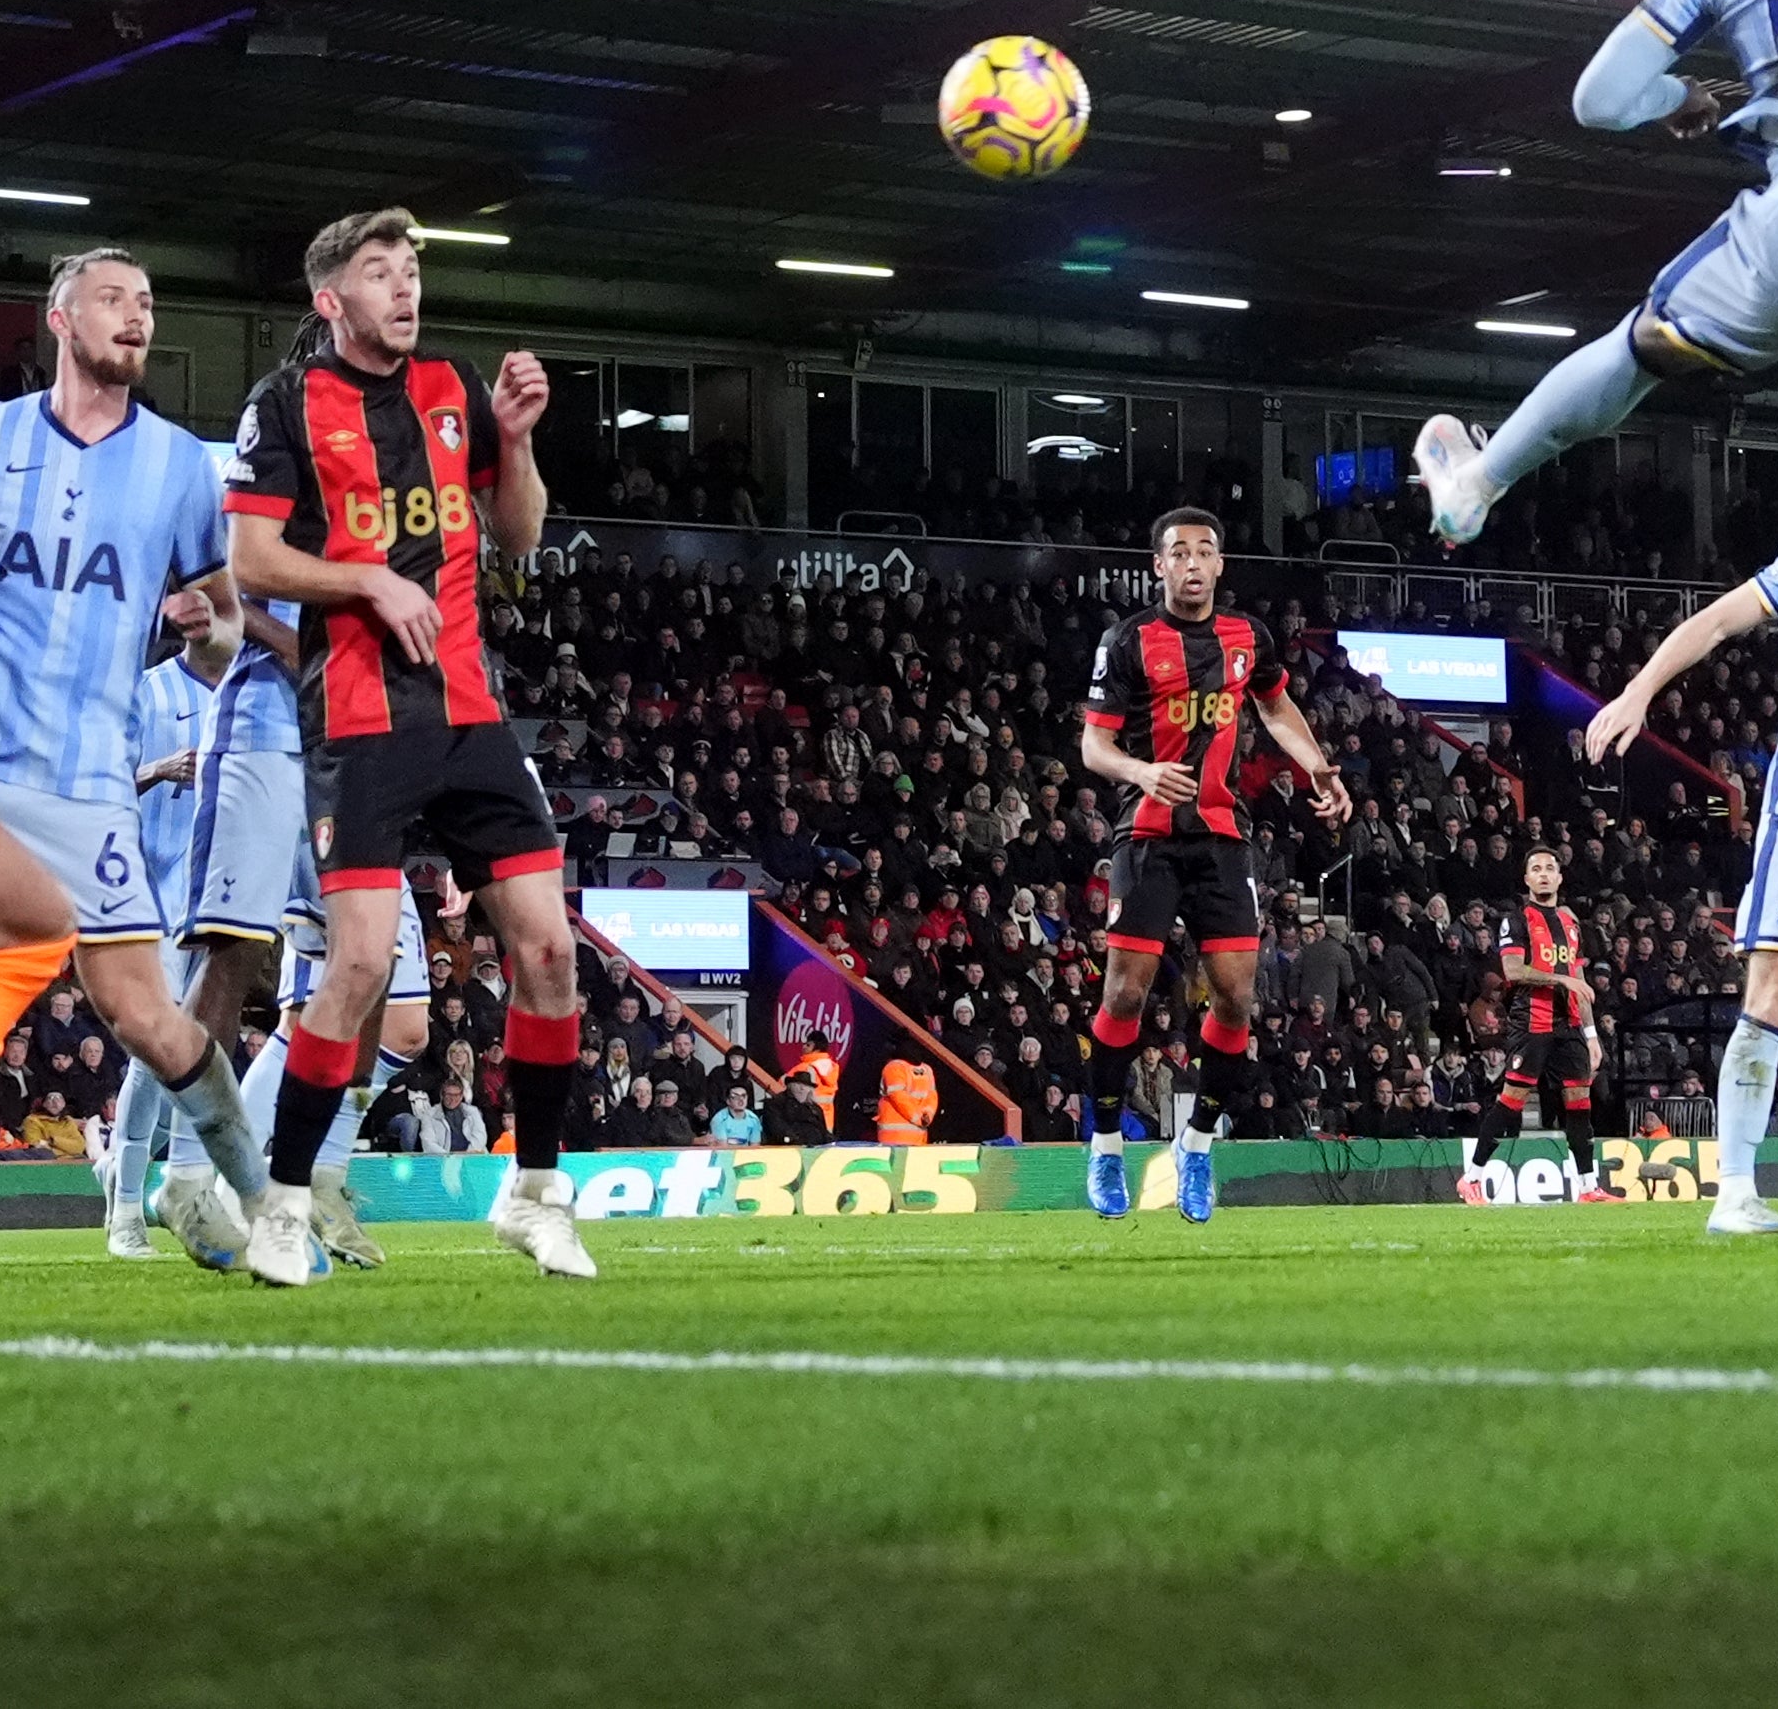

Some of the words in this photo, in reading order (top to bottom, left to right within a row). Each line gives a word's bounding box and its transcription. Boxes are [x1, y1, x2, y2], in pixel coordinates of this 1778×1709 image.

[345, 484, 470, 551] bj88
[1407, 660, 1439, 675] LAS
[1442, 661, 1498, 677] VEGAS
[1168, 690, 1235, 732] bj88
[95, 831, 130, 888] 6
[651, 922, 683, 937] LAS
[686, 923, 740, 937] VEGAS
[712, 973, 741, 984] WV2
